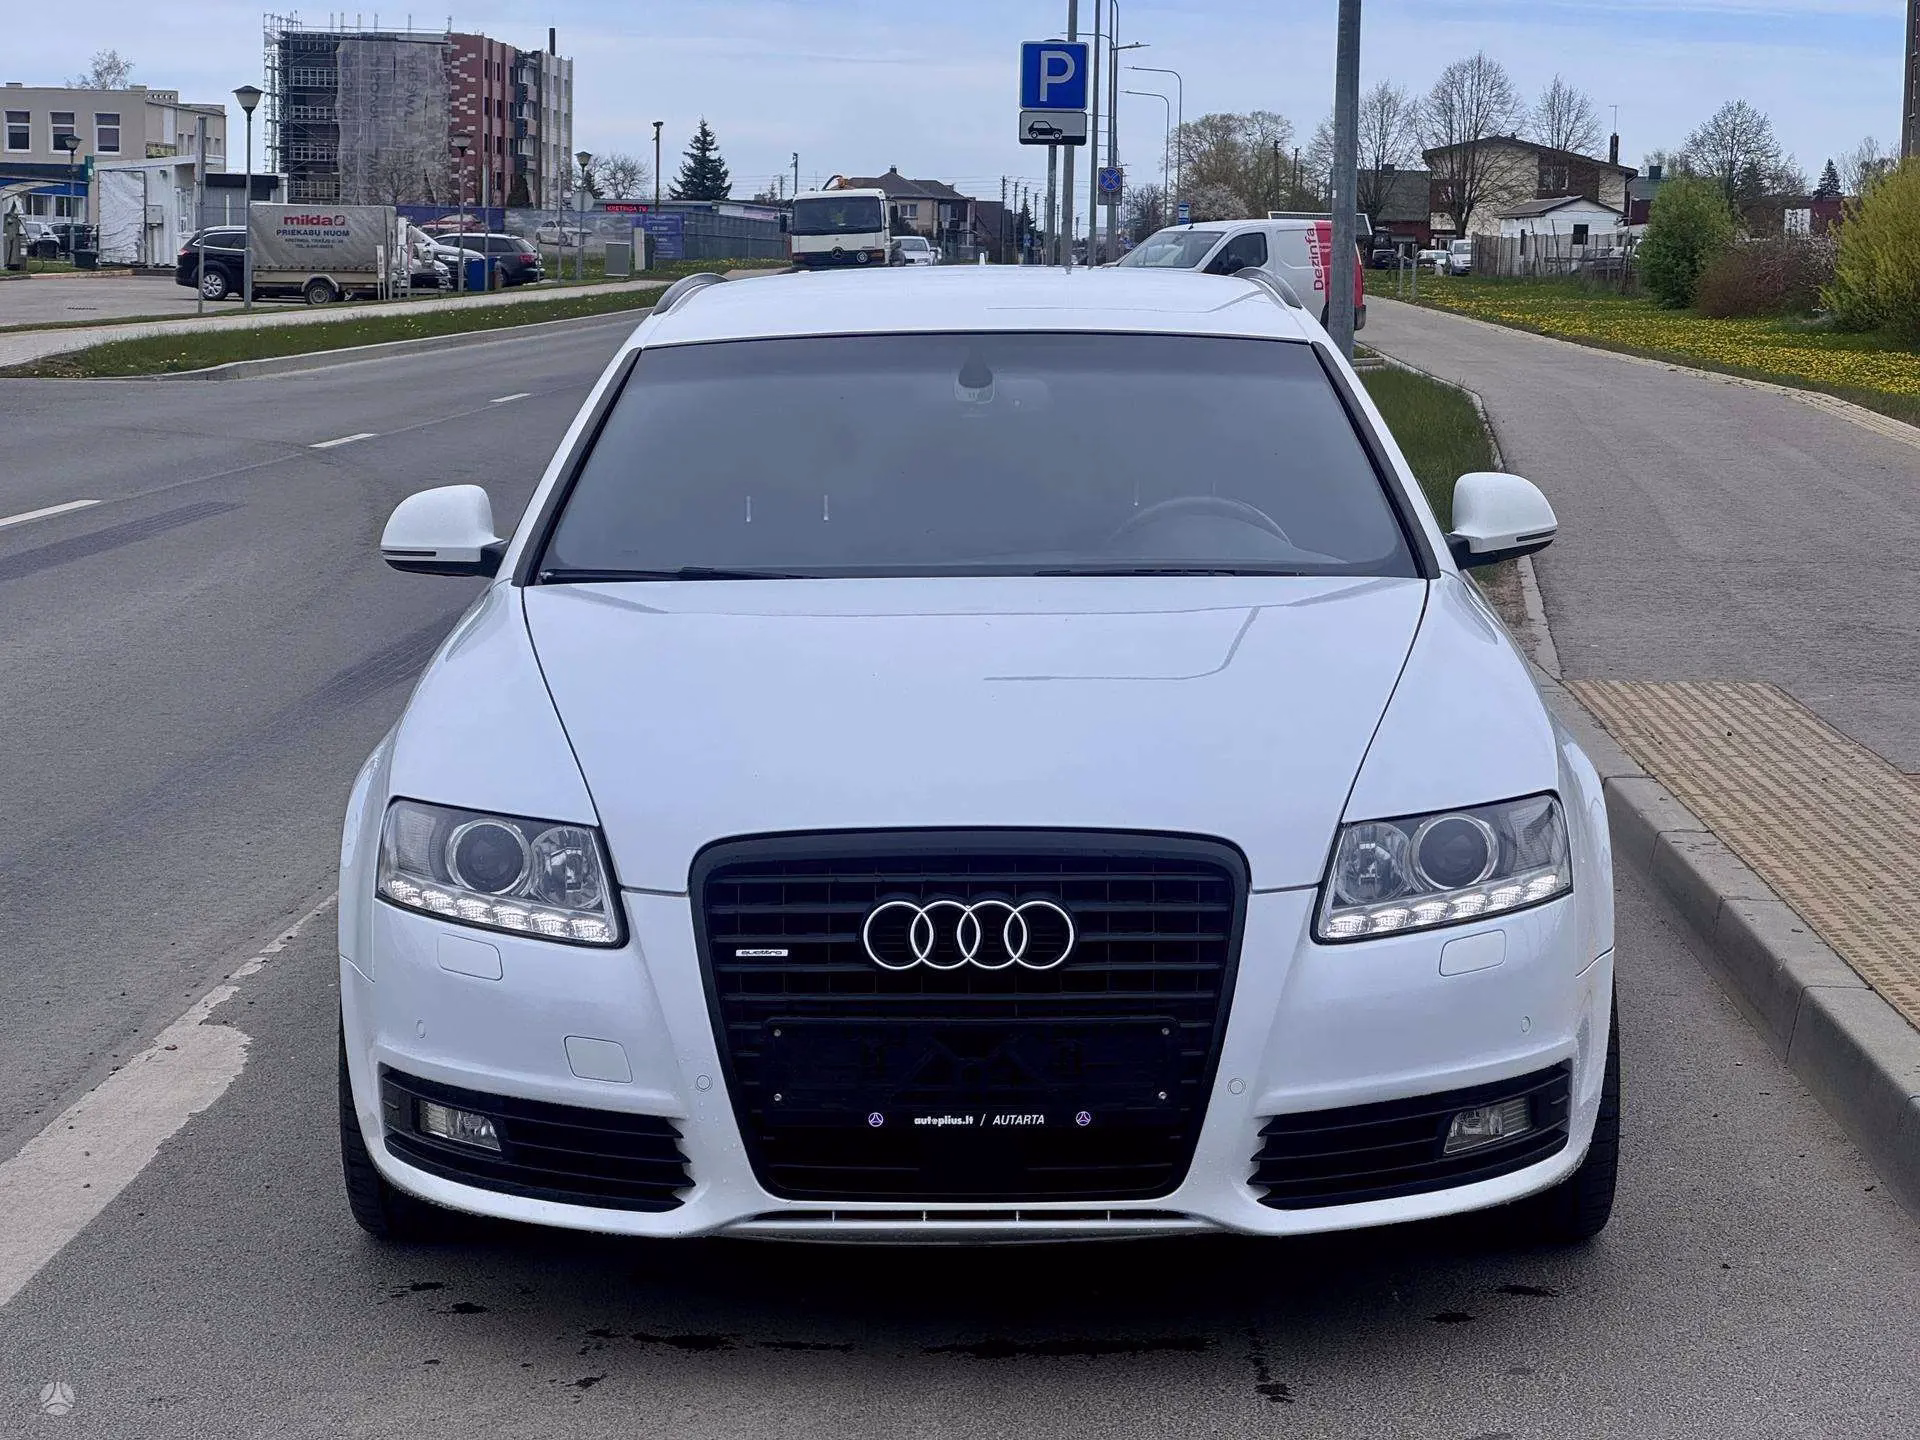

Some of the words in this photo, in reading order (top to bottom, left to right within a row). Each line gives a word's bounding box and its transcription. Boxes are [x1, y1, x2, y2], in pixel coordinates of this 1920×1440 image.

[1039, 50, 1076, 102] P
[283, 215, 333, 226] milda
[1305, 228, 1325, 291] Dezinfa
[913, 1115, 974, 1127] autoplius.lt
[992, 1114, 1045, 1126] AUTARTA
